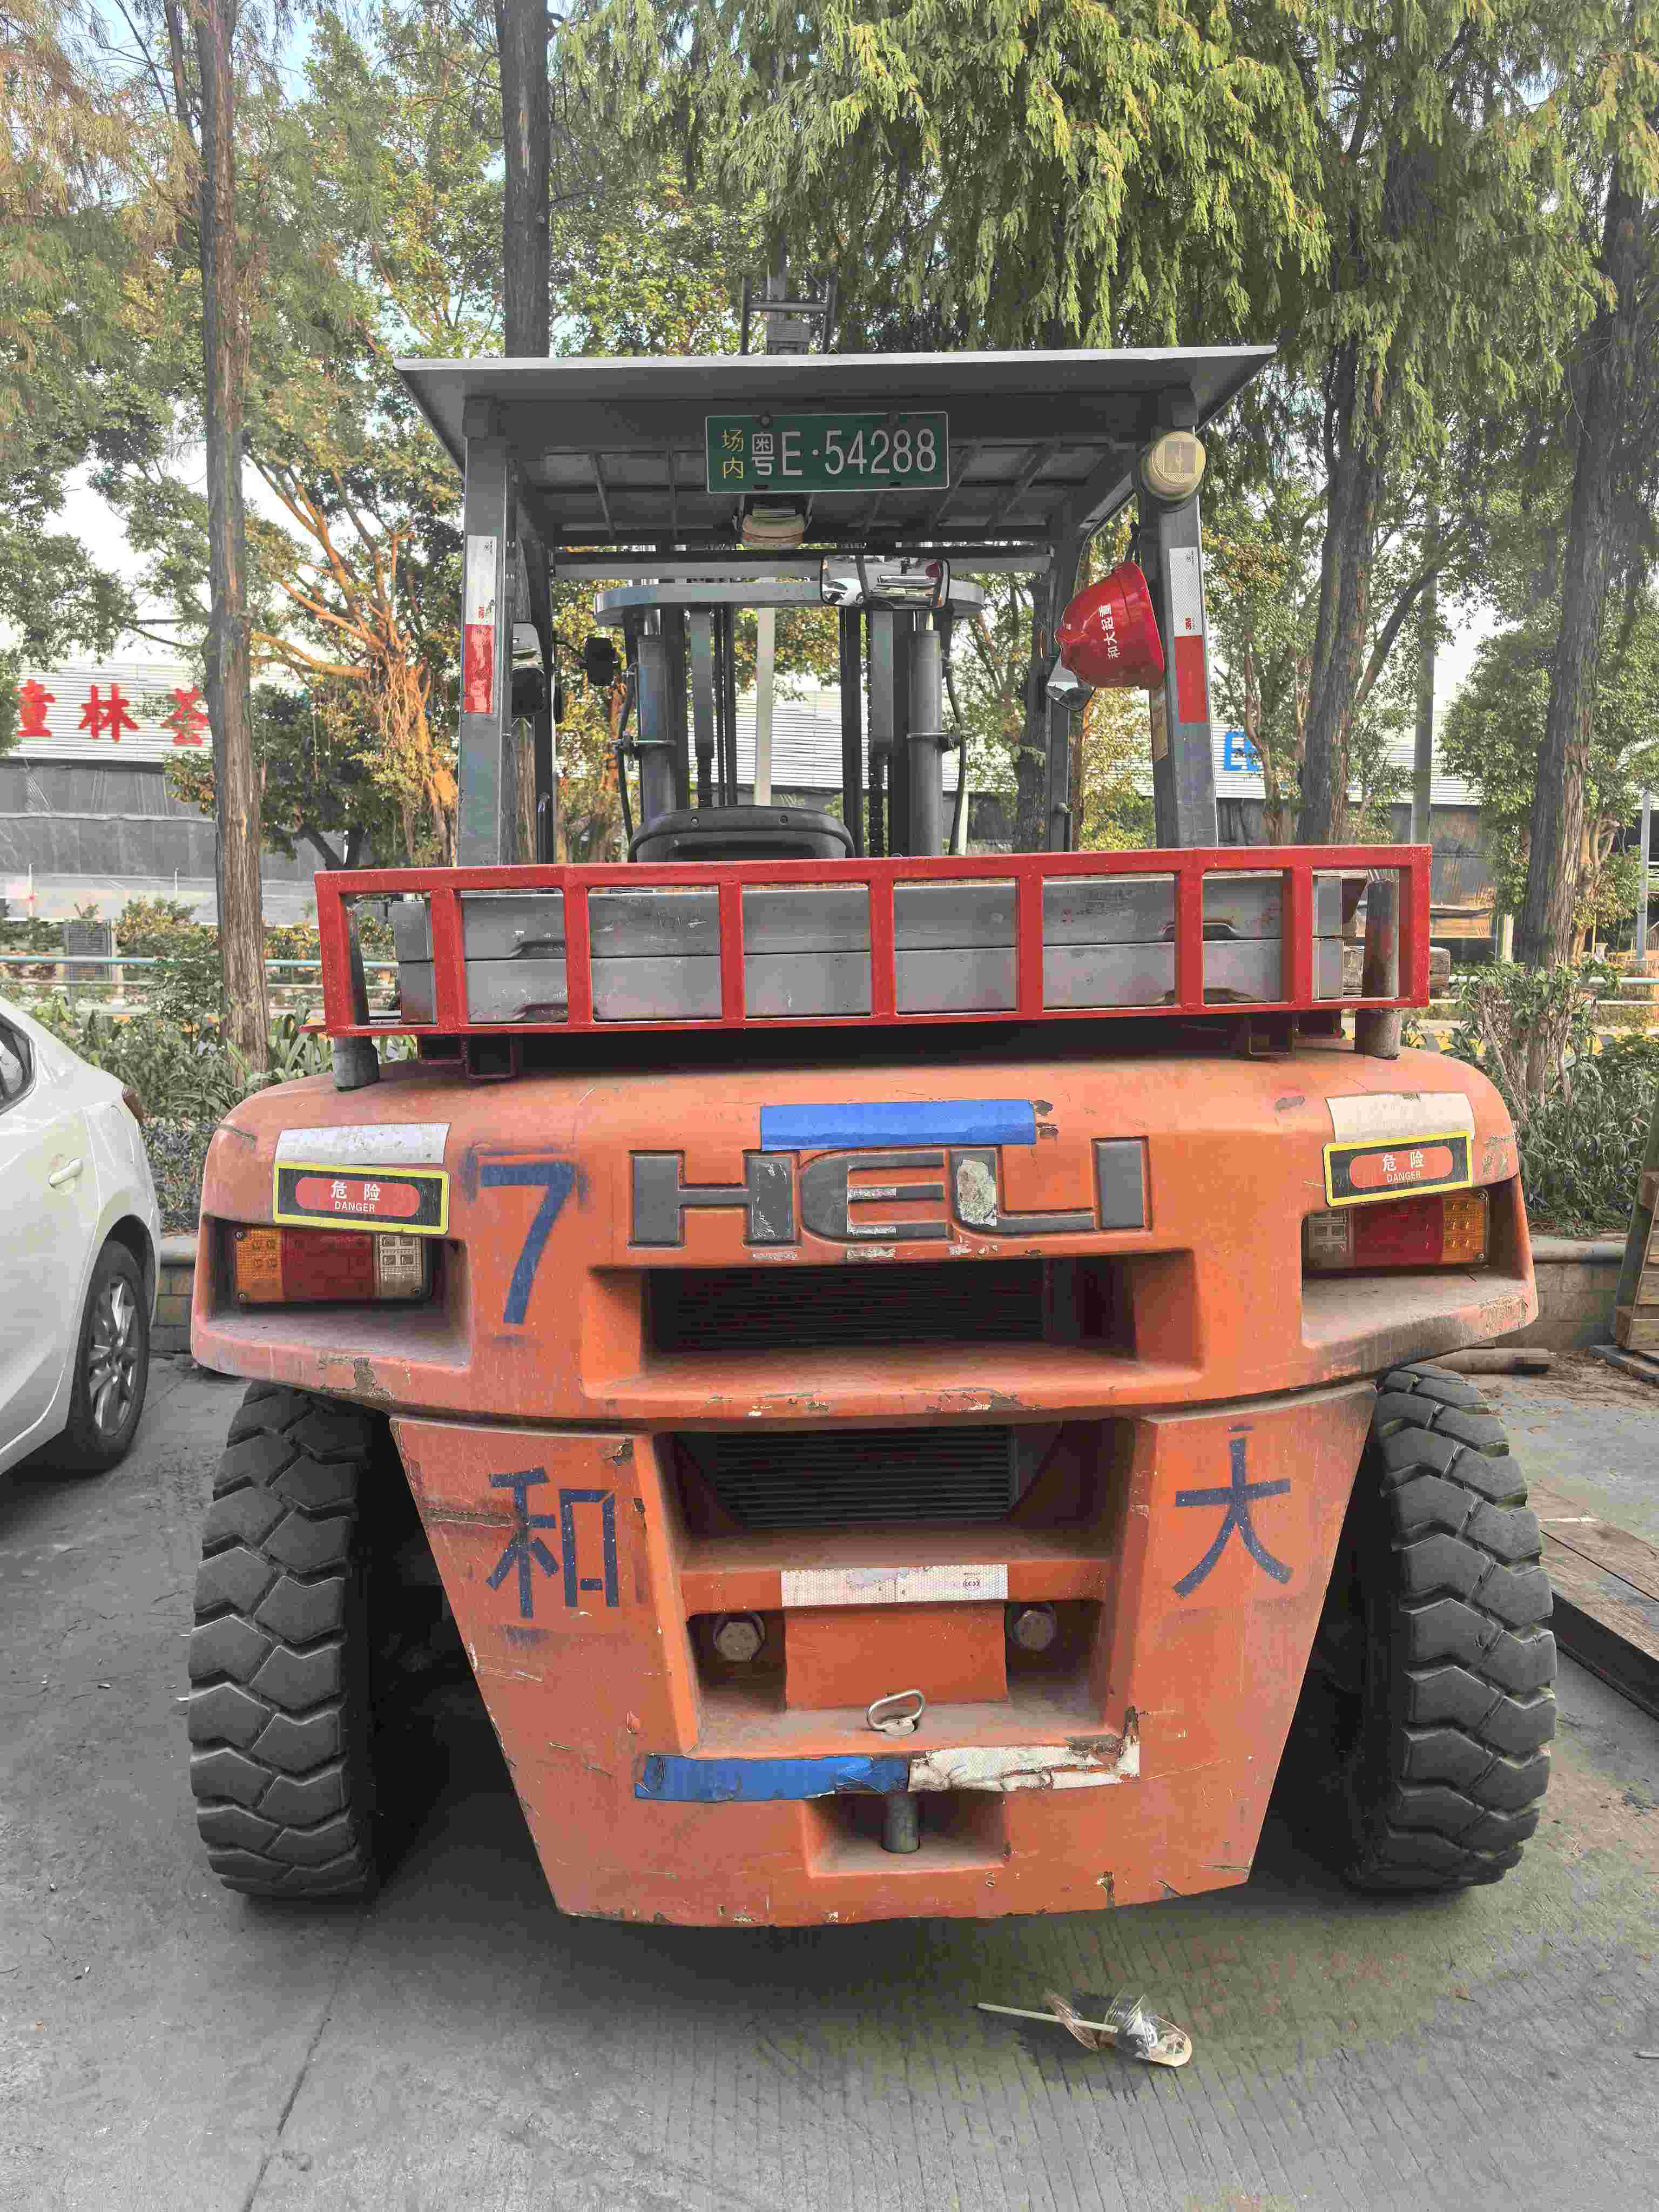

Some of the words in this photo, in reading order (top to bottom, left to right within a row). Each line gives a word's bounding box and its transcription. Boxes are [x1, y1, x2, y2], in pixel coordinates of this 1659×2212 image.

[721, 428, 743, 480] 场内
[1098, 604, 1120, 659] 和大起重
[1382, 1150, 1424, 1171] 危险
[1386, 1170, 1421, 1183] DANGER
[331, 1179, 381, 1201] 危险
[334, 1201, 375, 1212] DANGER
[630, 1137, 1148, 1243] HELI
[480, 1160, 576, 1324] 7
[486, 1466, 619, 1619] 和
[1173, 1438, 1293, 1597] 大
